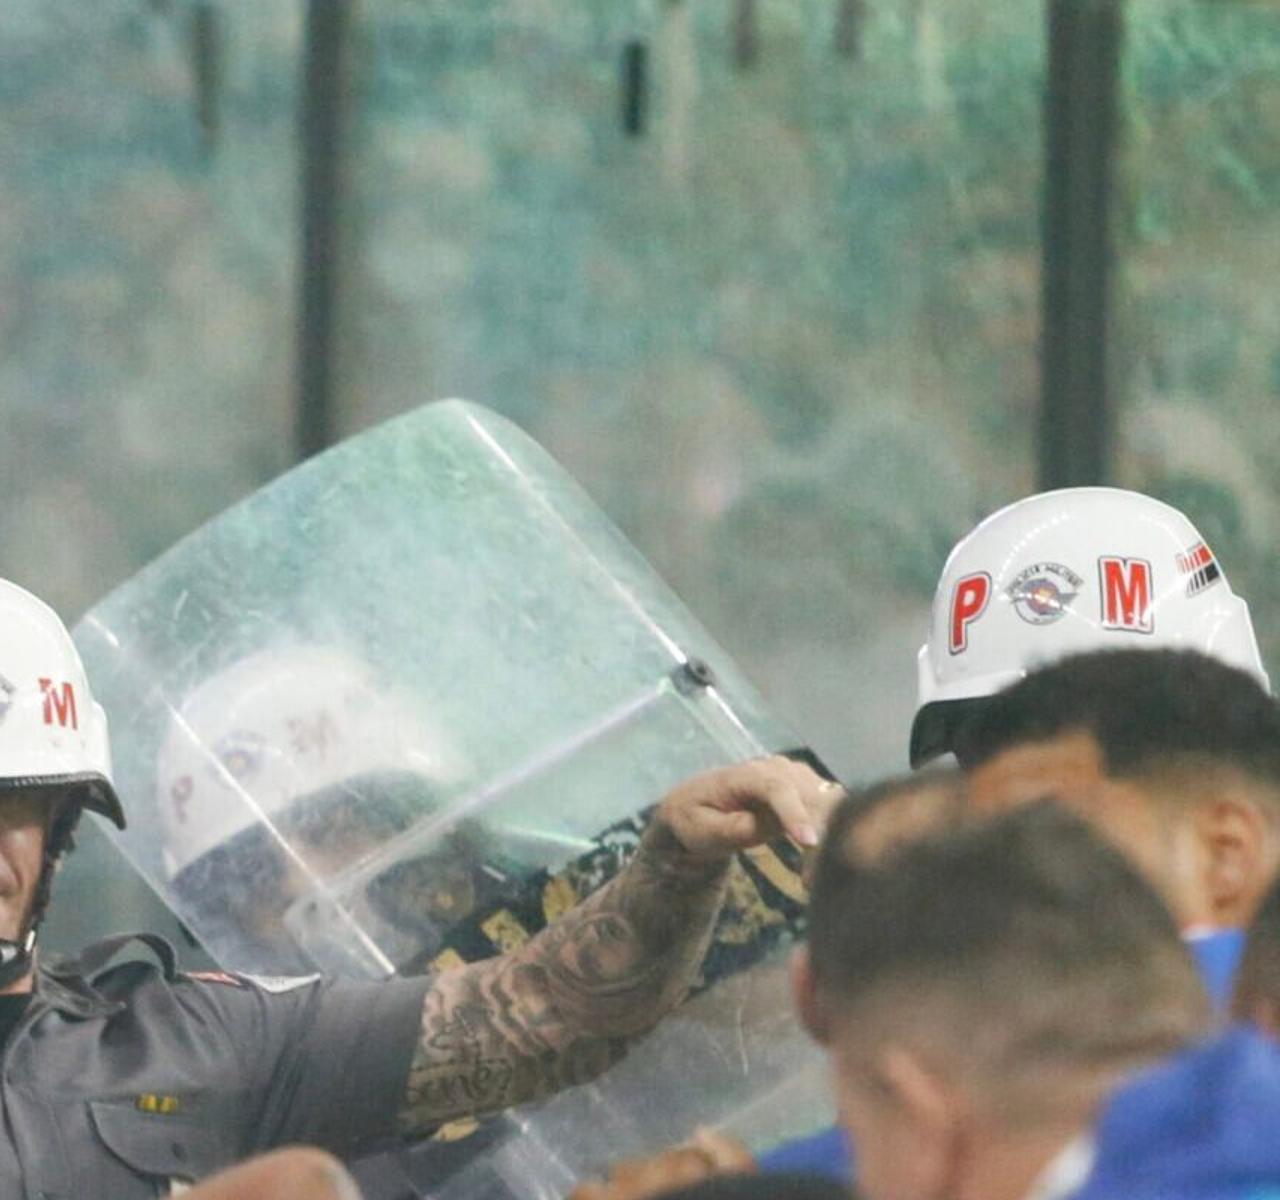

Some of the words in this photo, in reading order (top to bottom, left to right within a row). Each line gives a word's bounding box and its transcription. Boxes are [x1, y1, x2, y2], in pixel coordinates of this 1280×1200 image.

[950, 572, 992, 655] P
[1099, 556, 1154, 634] M
[38, 677, 78, 731] M
